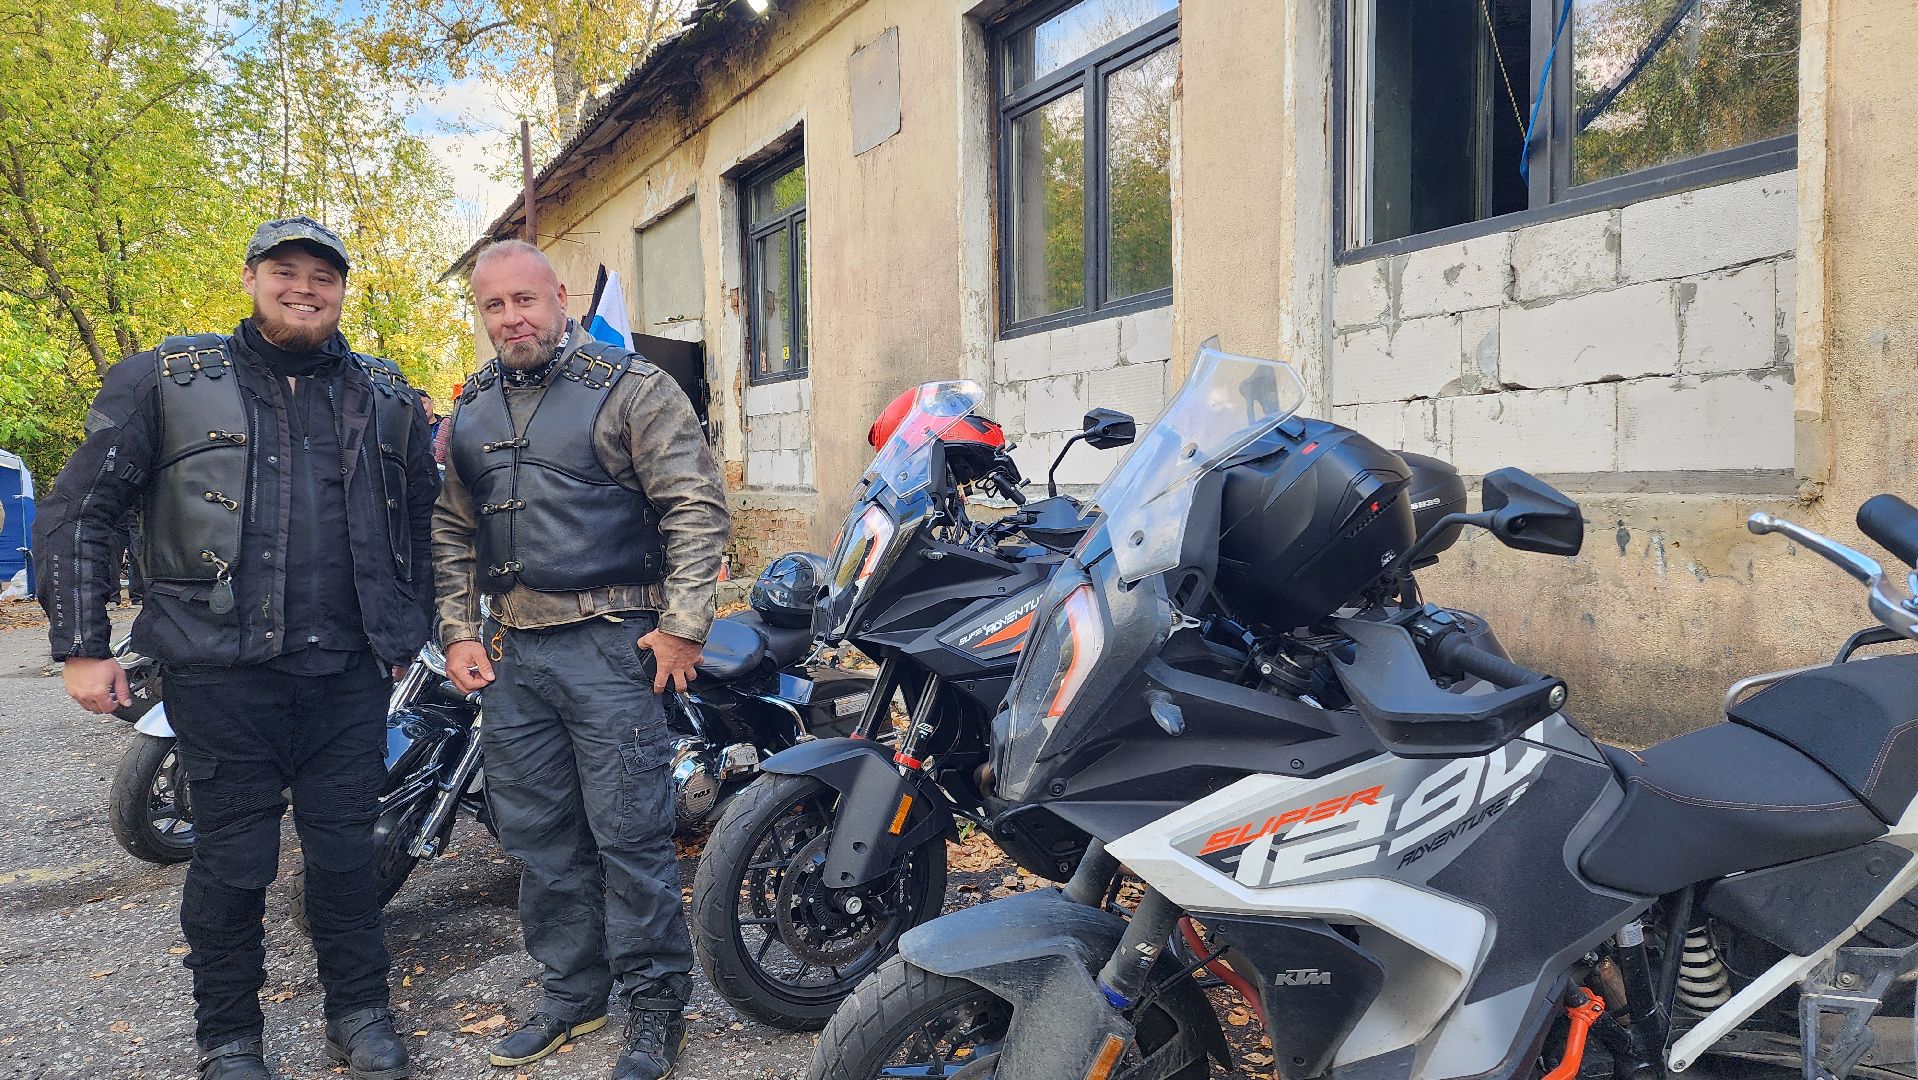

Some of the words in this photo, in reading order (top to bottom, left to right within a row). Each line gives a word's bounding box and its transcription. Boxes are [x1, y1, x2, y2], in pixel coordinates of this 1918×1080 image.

[984, 594, 1044, 637] ADVENTU
[1199, 784, 1386, 857] SUPER
[1396, 795, 1509, 871] ADVENTURE
[1507, 781, 1530, 807] S
[1274, 968, 1332, 986] KTM
